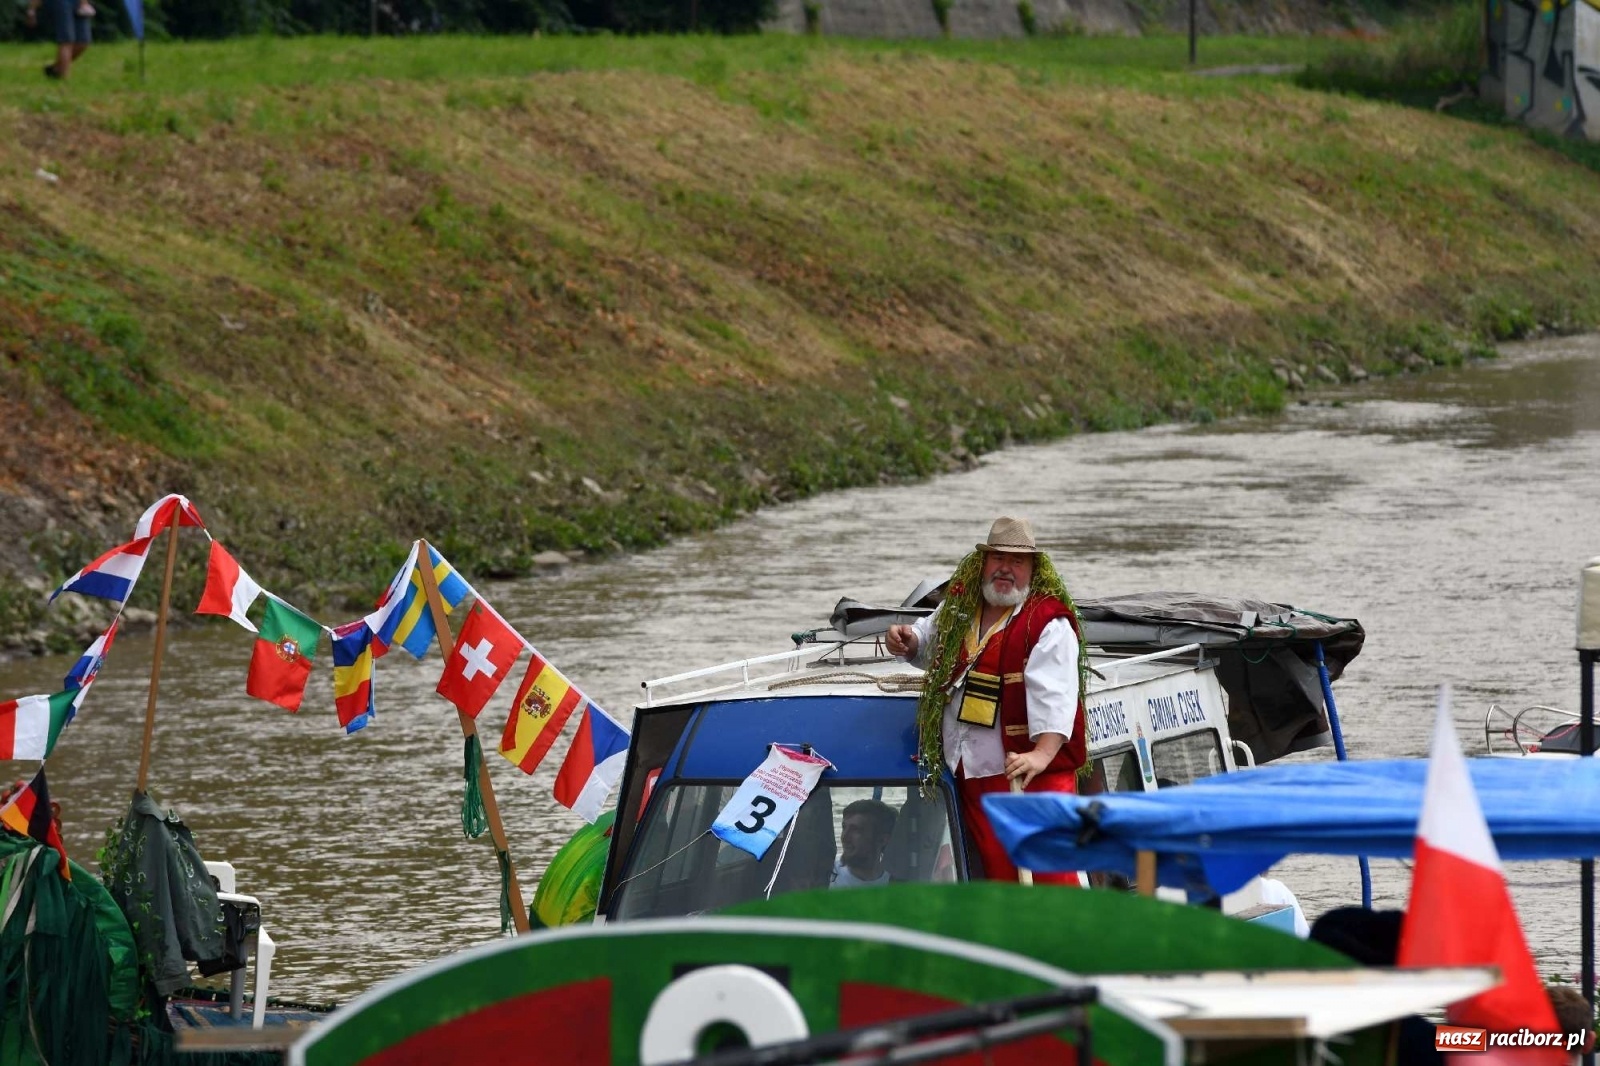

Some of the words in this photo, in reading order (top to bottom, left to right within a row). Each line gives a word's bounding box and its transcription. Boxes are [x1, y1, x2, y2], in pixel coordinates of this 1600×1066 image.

[1147, 696, 1179, 732] GMINA
[1177, 690, 1206, 725] CISEK
[735, 795, 776, 833] 3
